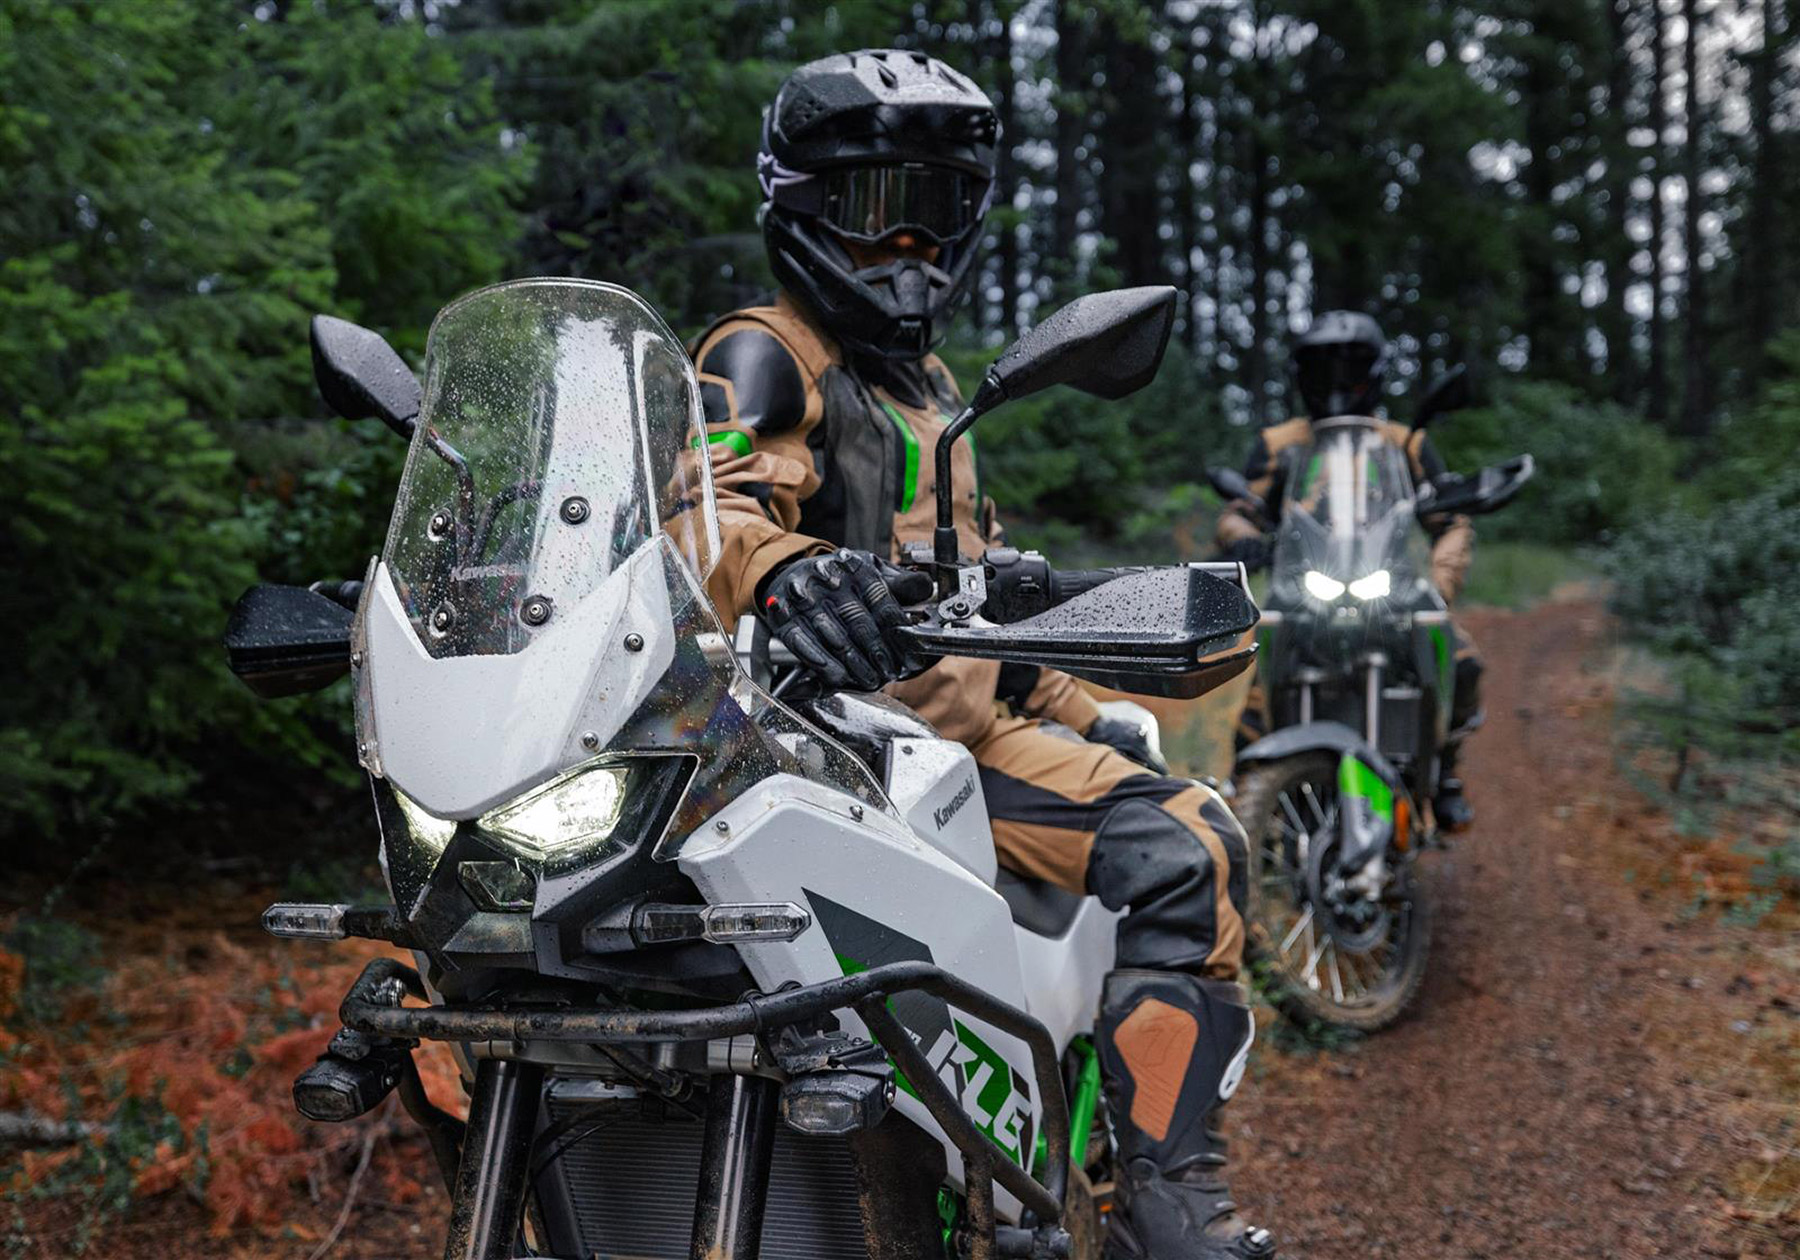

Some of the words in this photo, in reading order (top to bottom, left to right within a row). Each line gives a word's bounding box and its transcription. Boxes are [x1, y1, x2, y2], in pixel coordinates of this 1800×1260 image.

[450, 561, 531, 582] Kawasa
[933, 773, 976, 831] Kawasaki
[926, 1028, 1032, 1152] KLE
